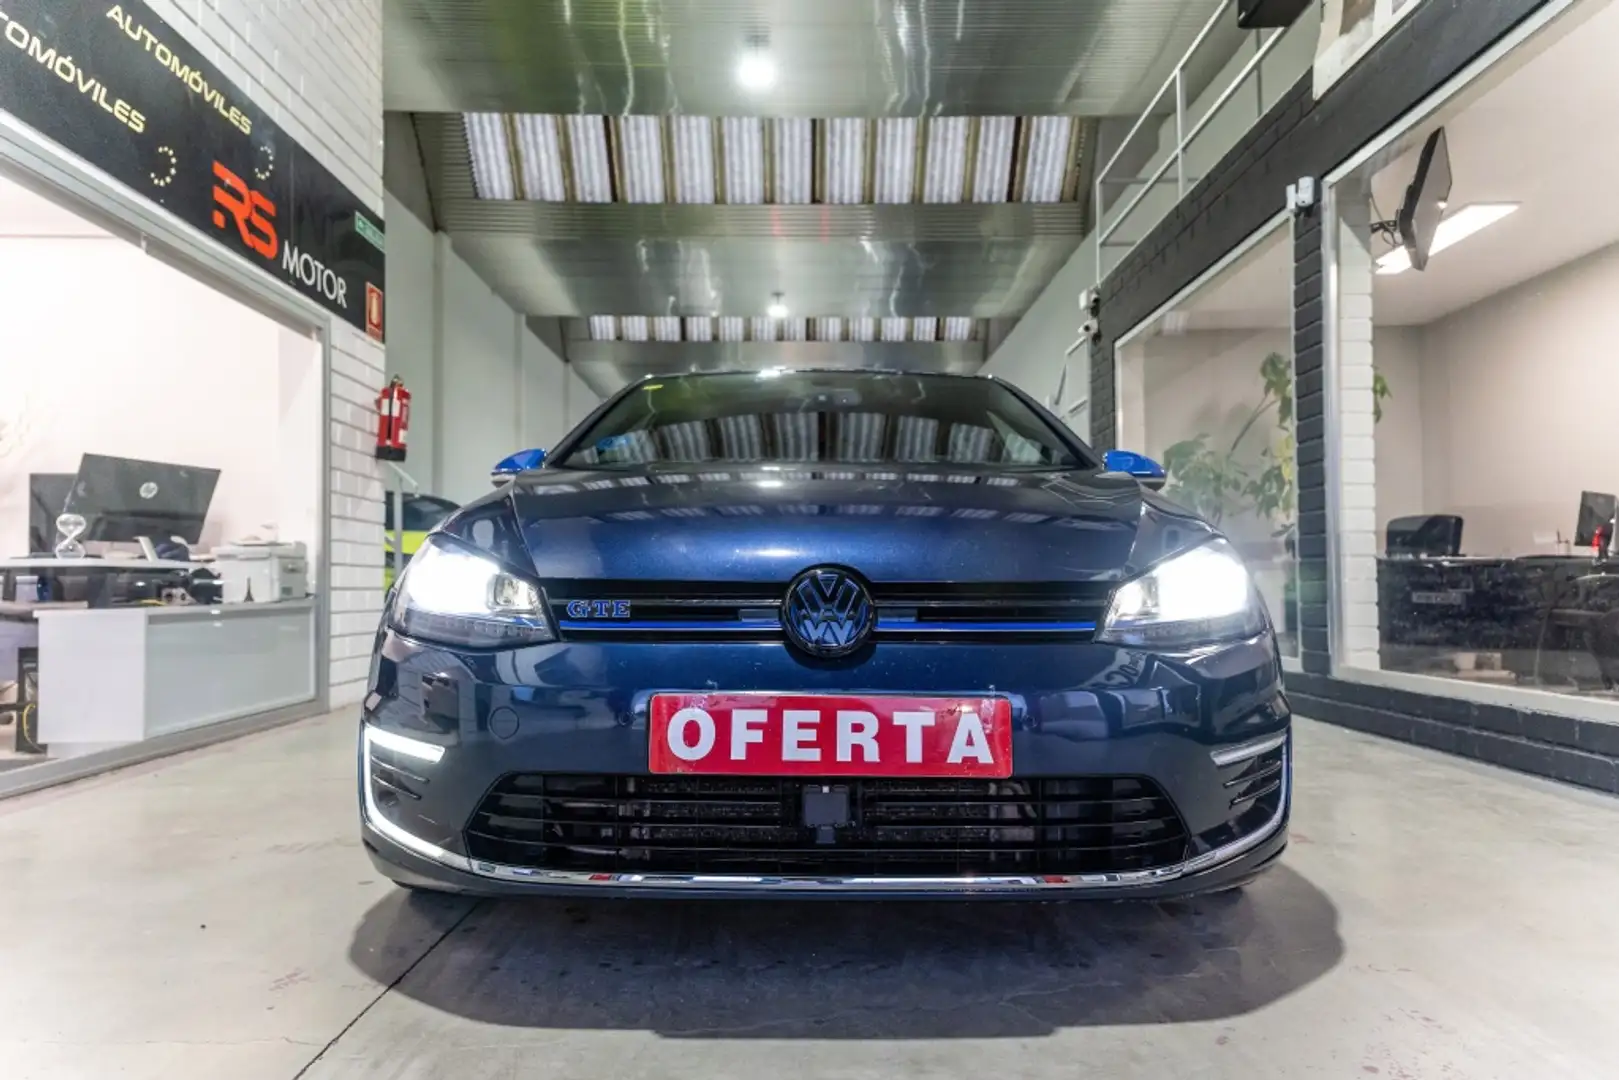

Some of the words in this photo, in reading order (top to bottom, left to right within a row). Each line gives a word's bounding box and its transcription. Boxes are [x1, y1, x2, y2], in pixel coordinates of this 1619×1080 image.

[106, 5, 252, 135] AUTOMÓVILES
[212, 160, 278, 260] RS
[282, 240, 347, 309] MOTOR
[566, 599, 631, 618] GTE
[667, 708, 994, 764] OFERTA
